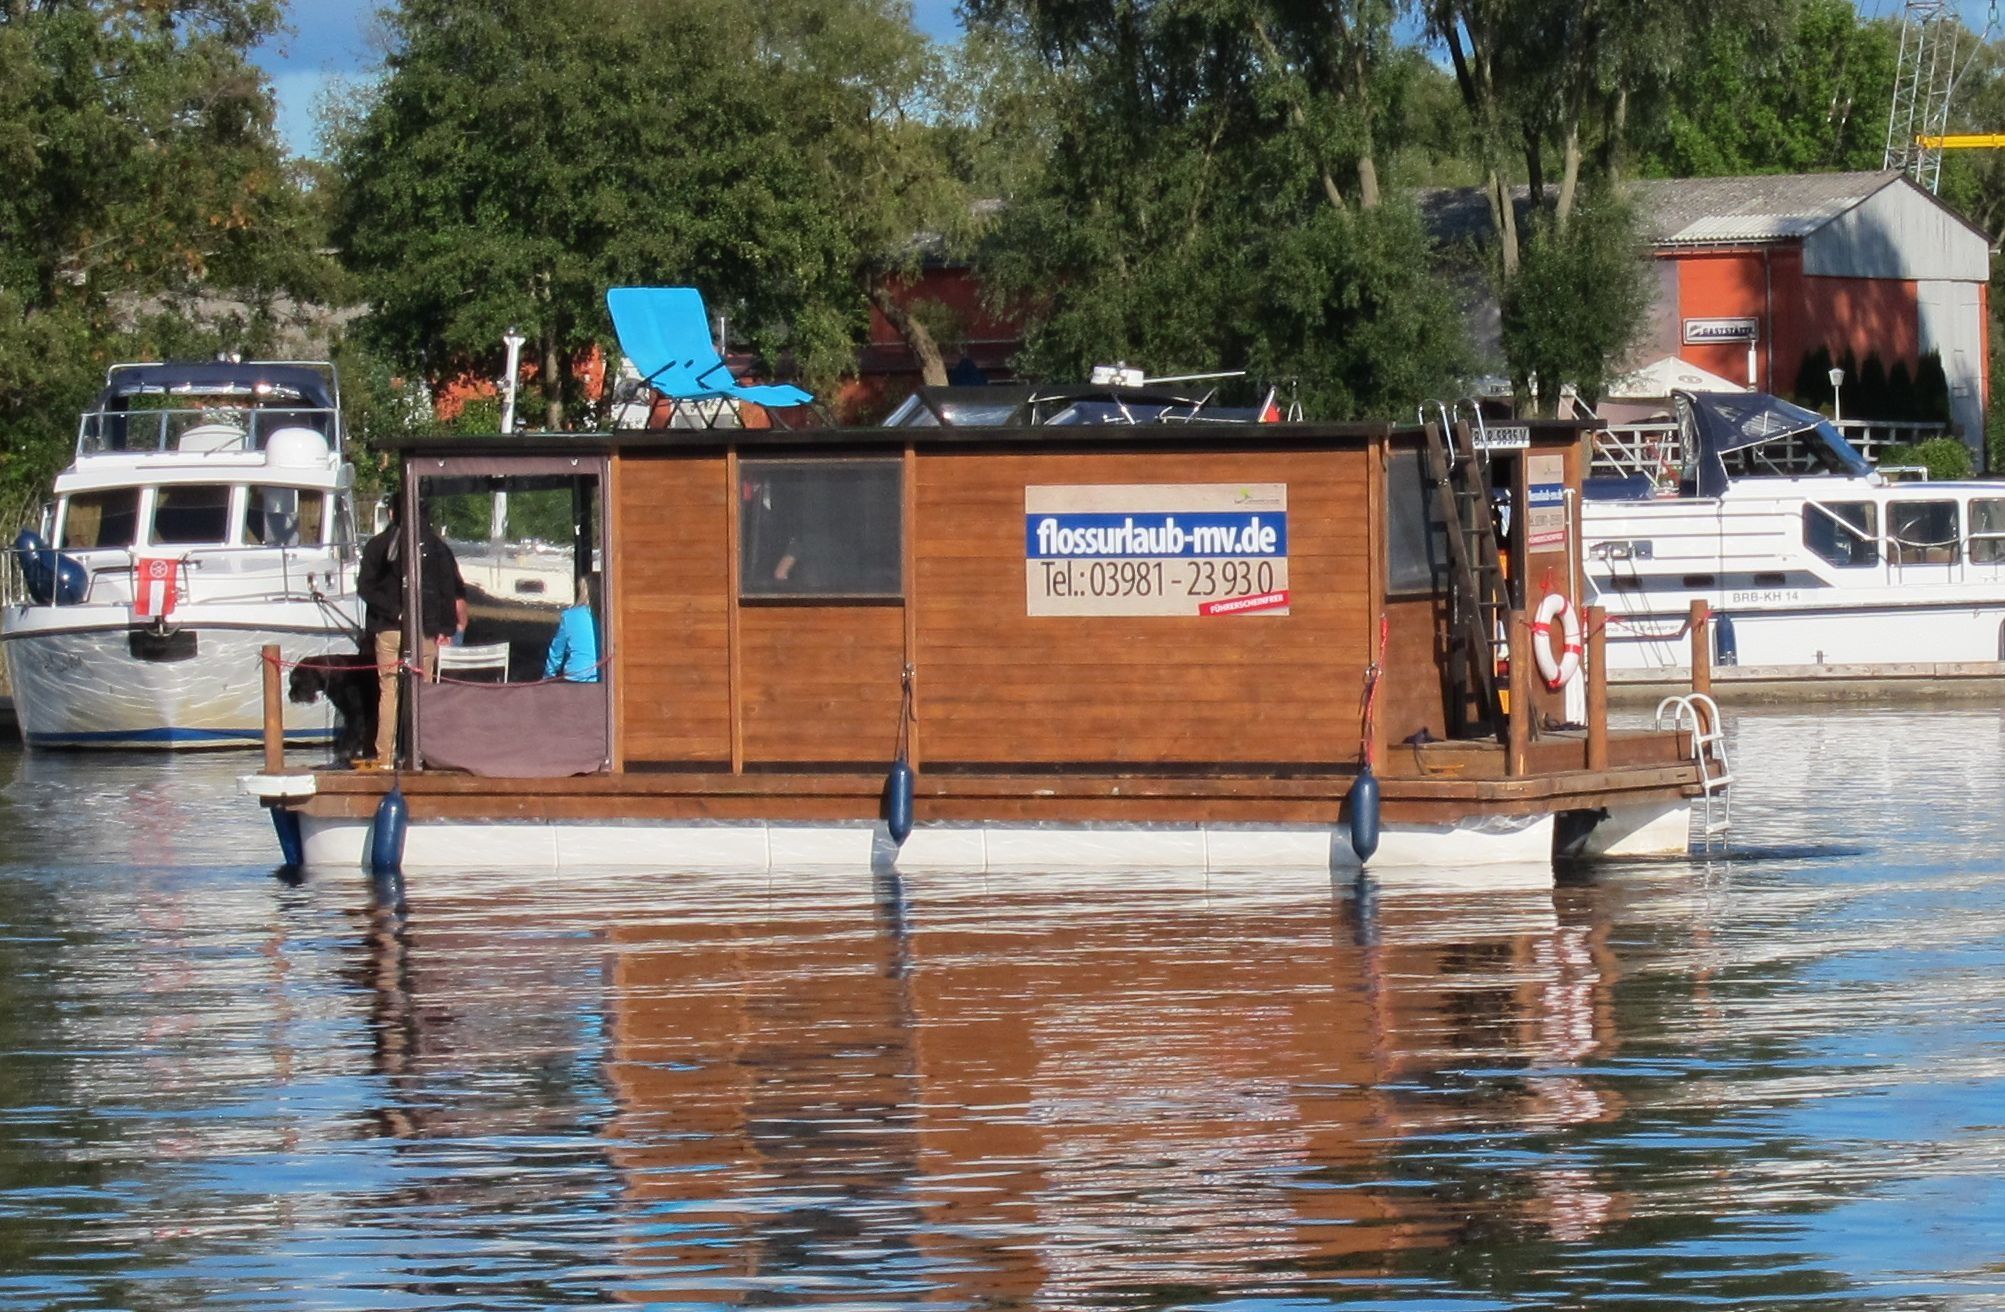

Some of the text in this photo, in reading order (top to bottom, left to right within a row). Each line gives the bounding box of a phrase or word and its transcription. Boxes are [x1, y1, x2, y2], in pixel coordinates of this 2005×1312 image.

[1037, 517, 1277, 554] flossurlaub-mv.de
[1041, 560, 1085, 596] Tel.:
[1090, 561, 1163, 596] 03981
[1733, 591, 1799, 603] BRB-KH 14
